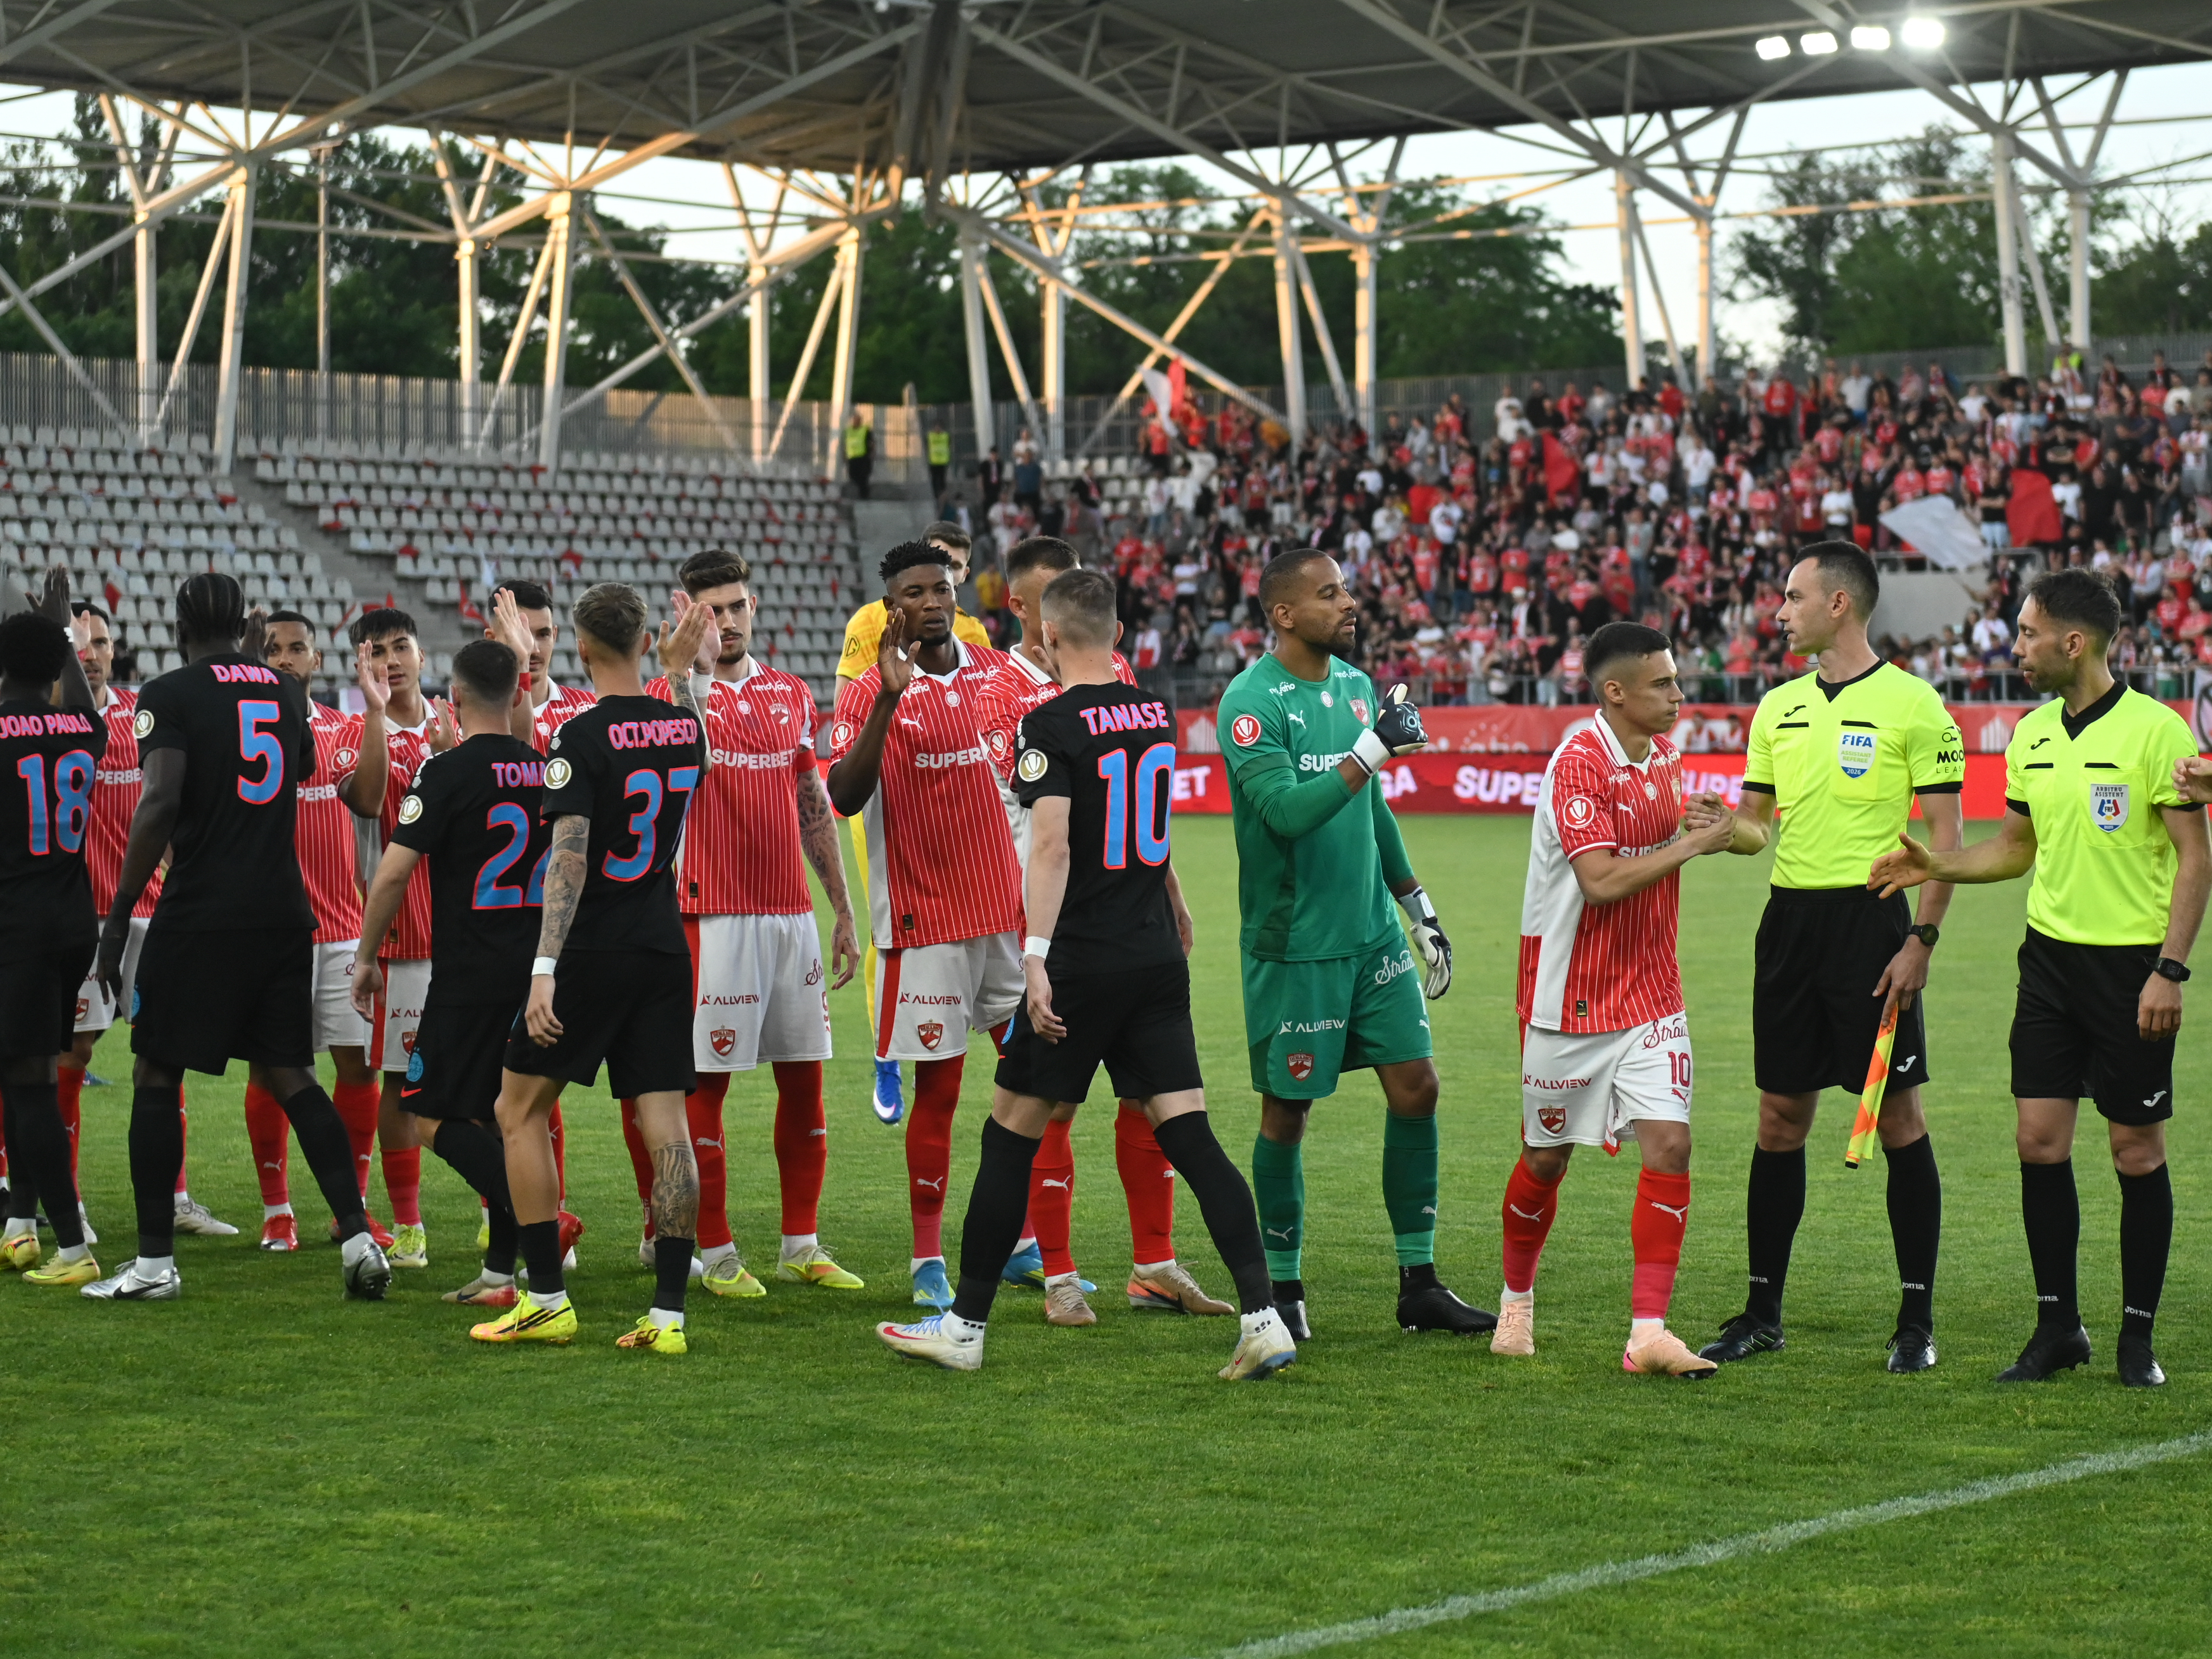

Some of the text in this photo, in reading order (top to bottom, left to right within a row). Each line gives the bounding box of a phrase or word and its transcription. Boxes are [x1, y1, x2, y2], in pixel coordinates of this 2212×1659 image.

[210, 664, 279, 685] DAWA
[0, 715, 44, 739] JOAO
[1080, 702, 1169, 735] TANASE
[1842, 734, 1873, 748] FIFA
[237, 700, 284, 804] 5
[711, 748, 796, 770] SUPERBET
[914, 747, 988, 770] SUPER
[1840, 750, 1872, 758] ASSISTANT
[1842, 756, 1869, 764] REFEREE
[16, 749, 96, 855] 18
[1097, 742, 1176, 870] 10
[602, 766, 699, 882] 37
[713, 994, 760, 1005] ALLVIEW
[912, 995, 962, 1005] ALLVIEW
[1295, 1019, 1346, 1033] ALLVIEW
[1667, 1051, 1691, 1088] 10
[1534, 1078, 1592, 1090] ALLVIEW
[2125, 1306, 2152, 1319] Joma
